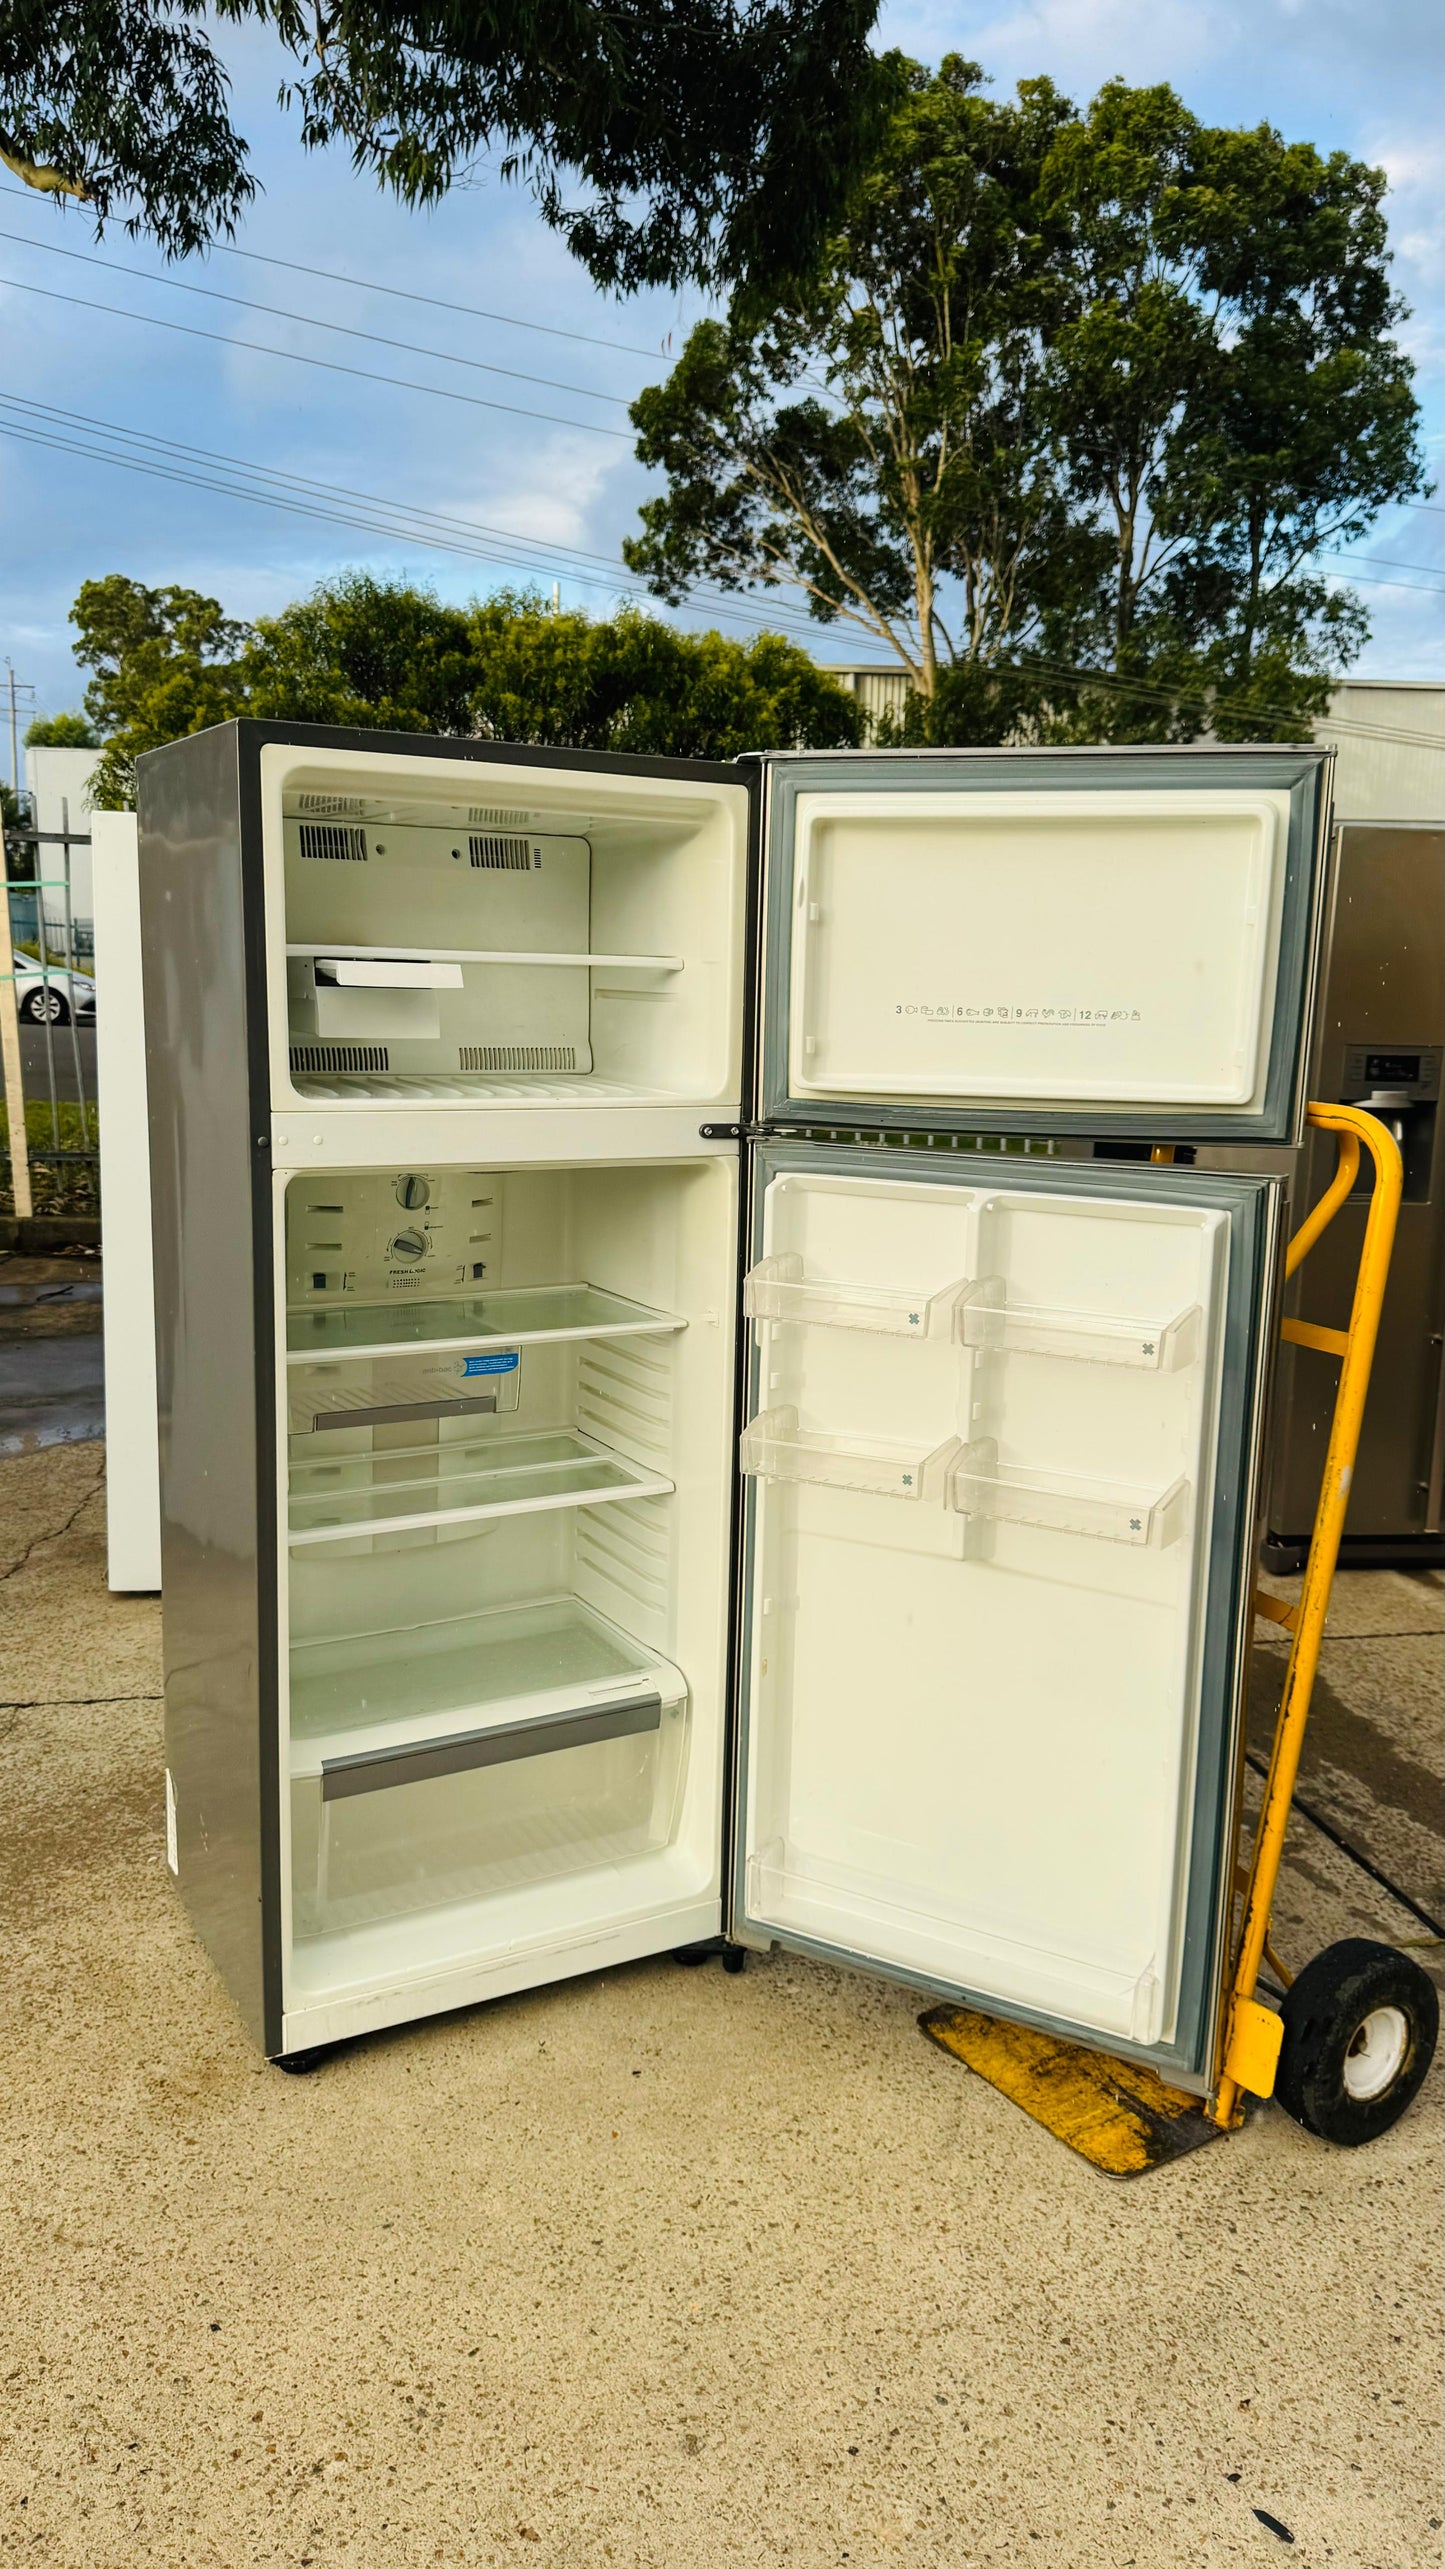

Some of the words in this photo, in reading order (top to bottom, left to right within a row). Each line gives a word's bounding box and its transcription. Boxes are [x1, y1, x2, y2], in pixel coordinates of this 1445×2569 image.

[895, 1005, 902, 1014] 3
[956, 1007, 963, 1016] 6
[1015, 1008, 1023, 1018] 9
[1079, 1010, 1091, 1020] 12
